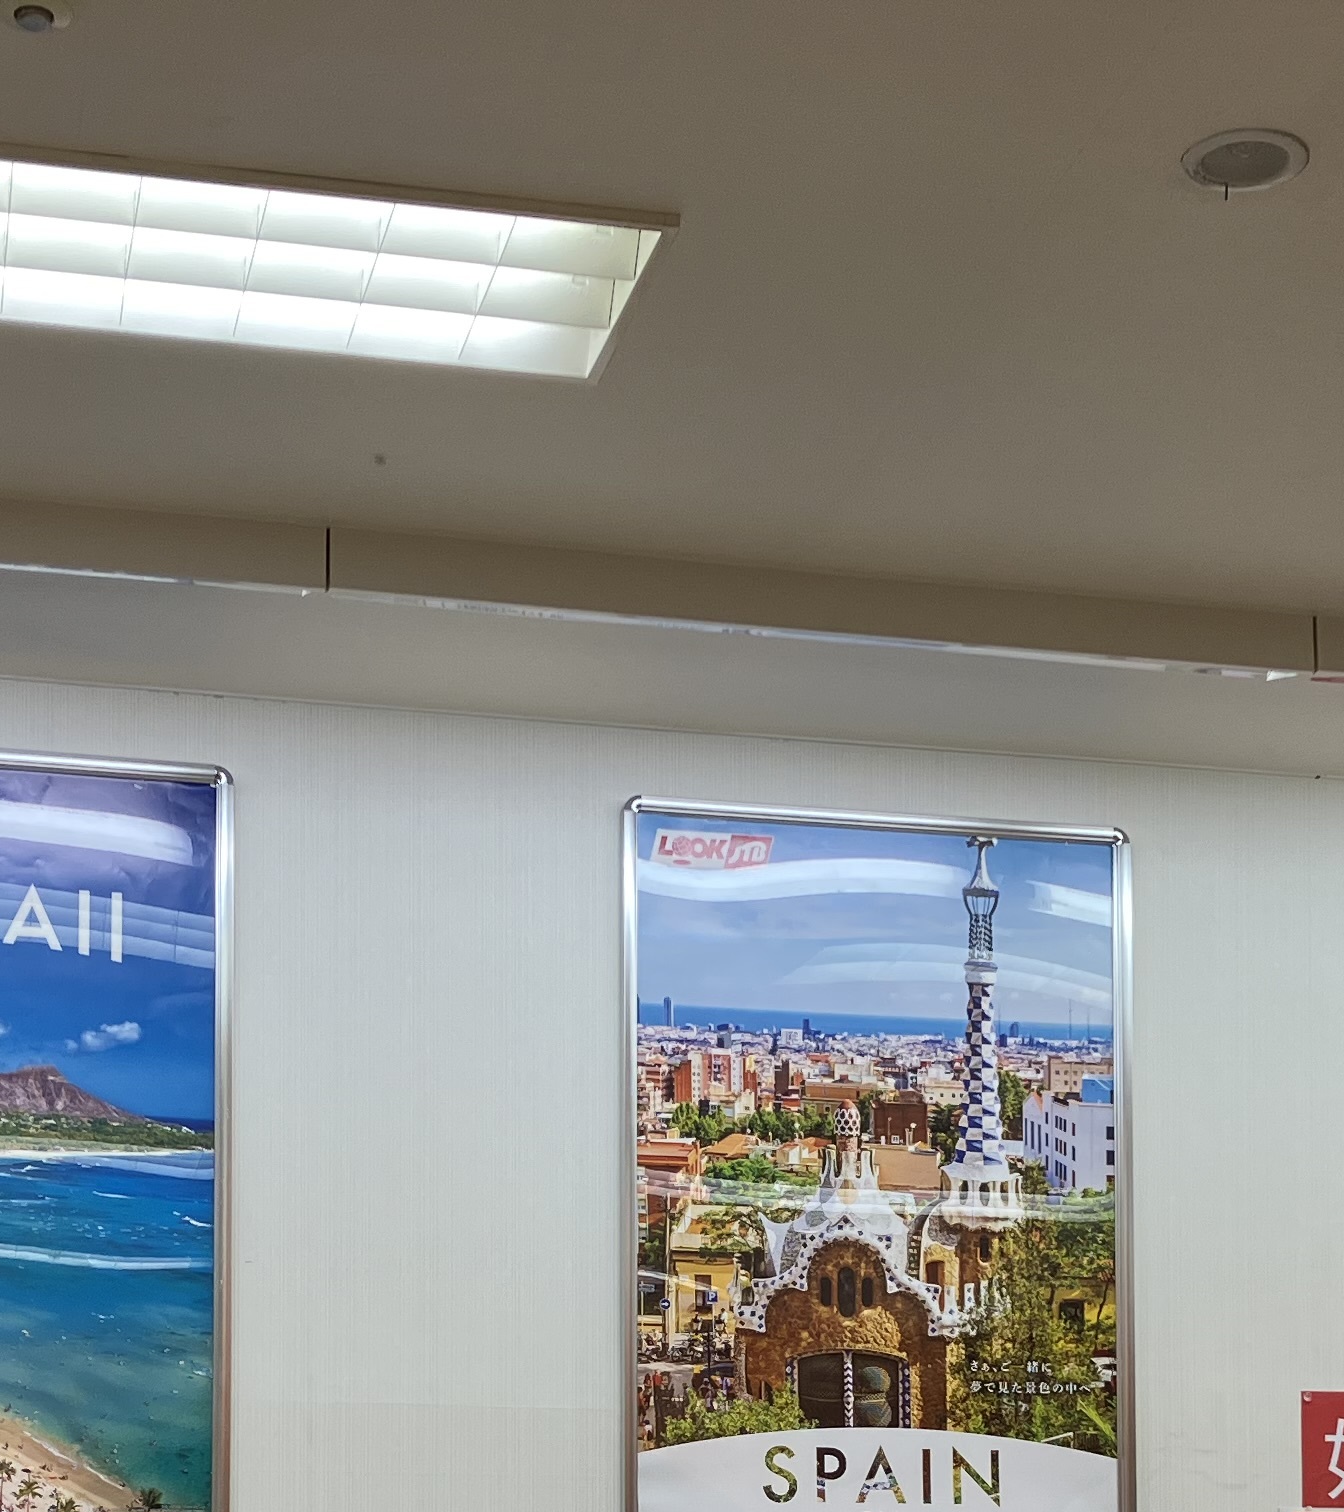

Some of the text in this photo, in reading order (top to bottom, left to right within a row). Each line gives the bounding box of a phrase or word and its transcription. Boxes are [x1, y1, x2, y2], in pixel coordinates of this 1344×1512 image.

[658, 836, 728, 859] LOOK
[970, 1381, 1091, 1394] 夢で見た景色の中へ
[762, 1445, 1001, 1507] SPAIN
